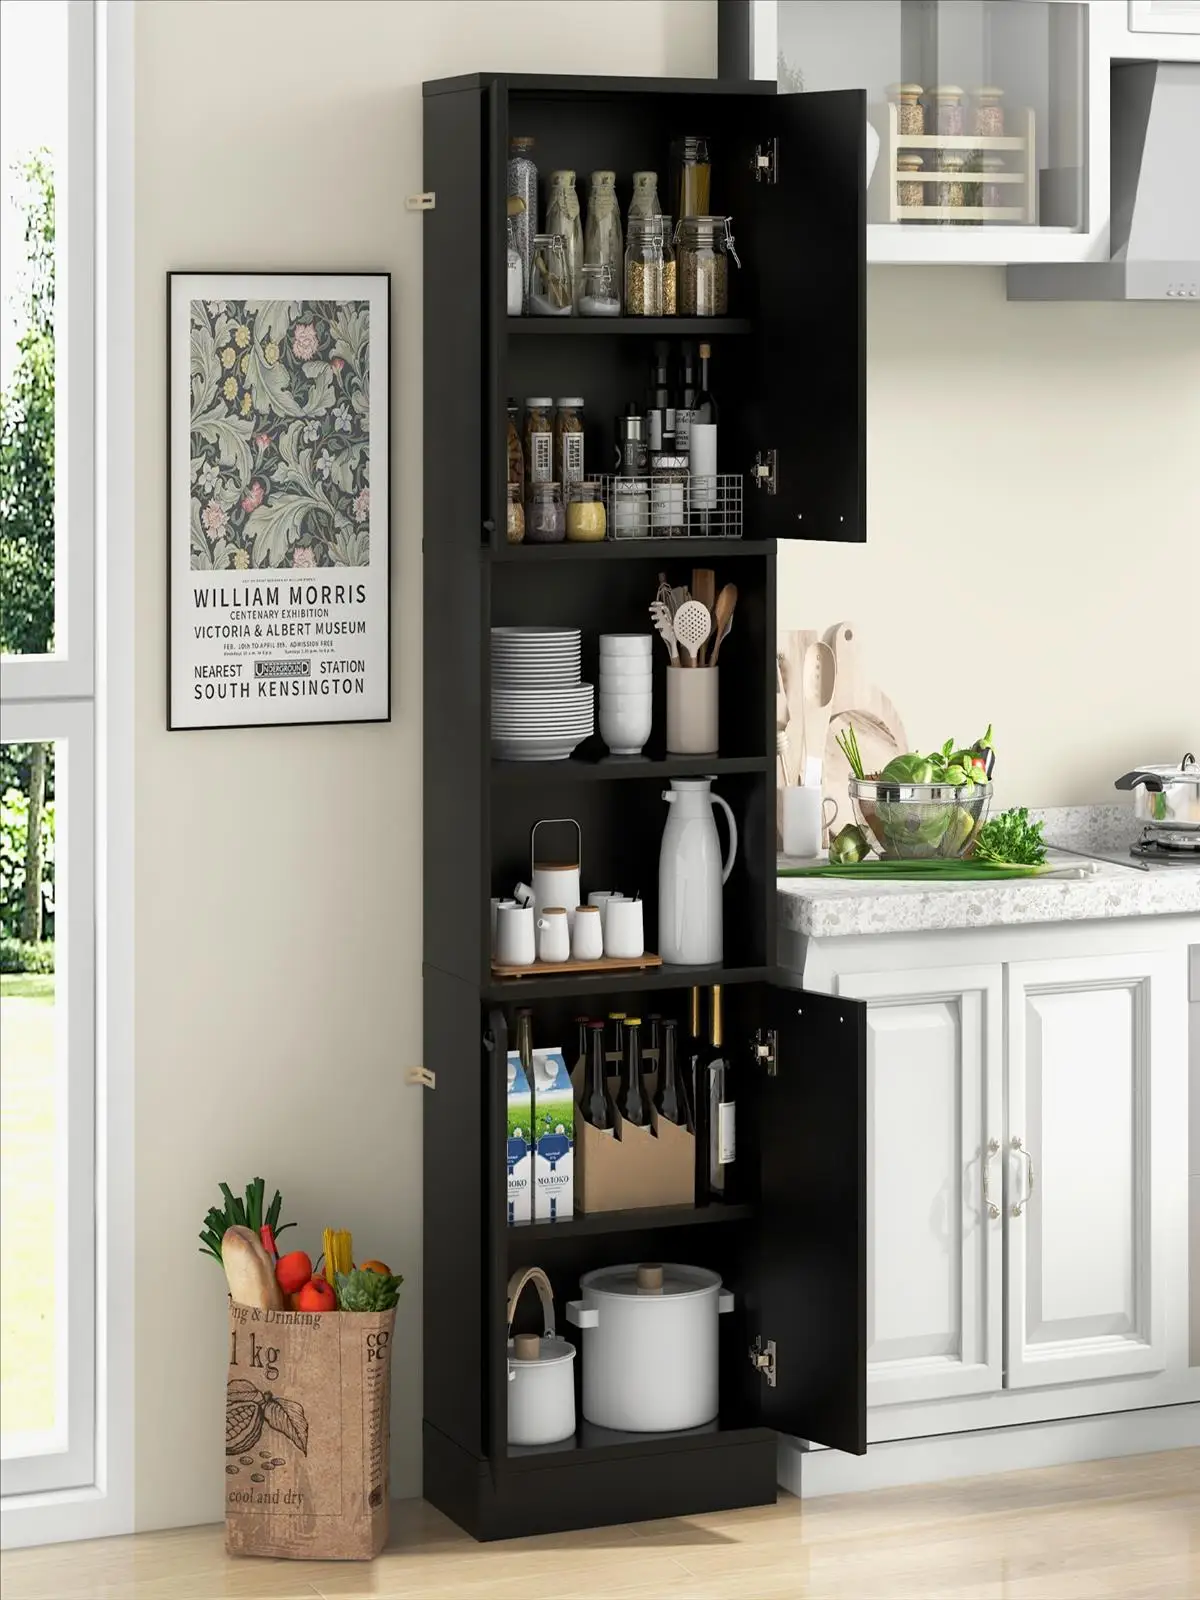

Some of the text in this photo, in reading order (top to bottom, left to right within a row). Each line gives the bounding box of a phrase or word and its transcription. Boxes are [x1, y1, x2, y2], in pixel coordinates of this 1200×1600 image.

[193, 584, 367, 608] WILLIAM MORRIS
[230, 608, 329, 620] CENTENARY EXHIBITION
[194, 621, 366, 639] VICTORIA & ALBERT MUSEUM
[194, 660, 365, 679] NEAREST UNDERGROUND STATION
[194, 678, 365, 700] SOUTH KENSINGTON
[537, 1175, 569, 1186] МОЛОКО
[251, 1307, 263, 1321] &
[265, 1309, 322, 1331] Drinking
[248, 1332, 280, 1381] kg
[228, 1487, 306, 1510] cool and dry
